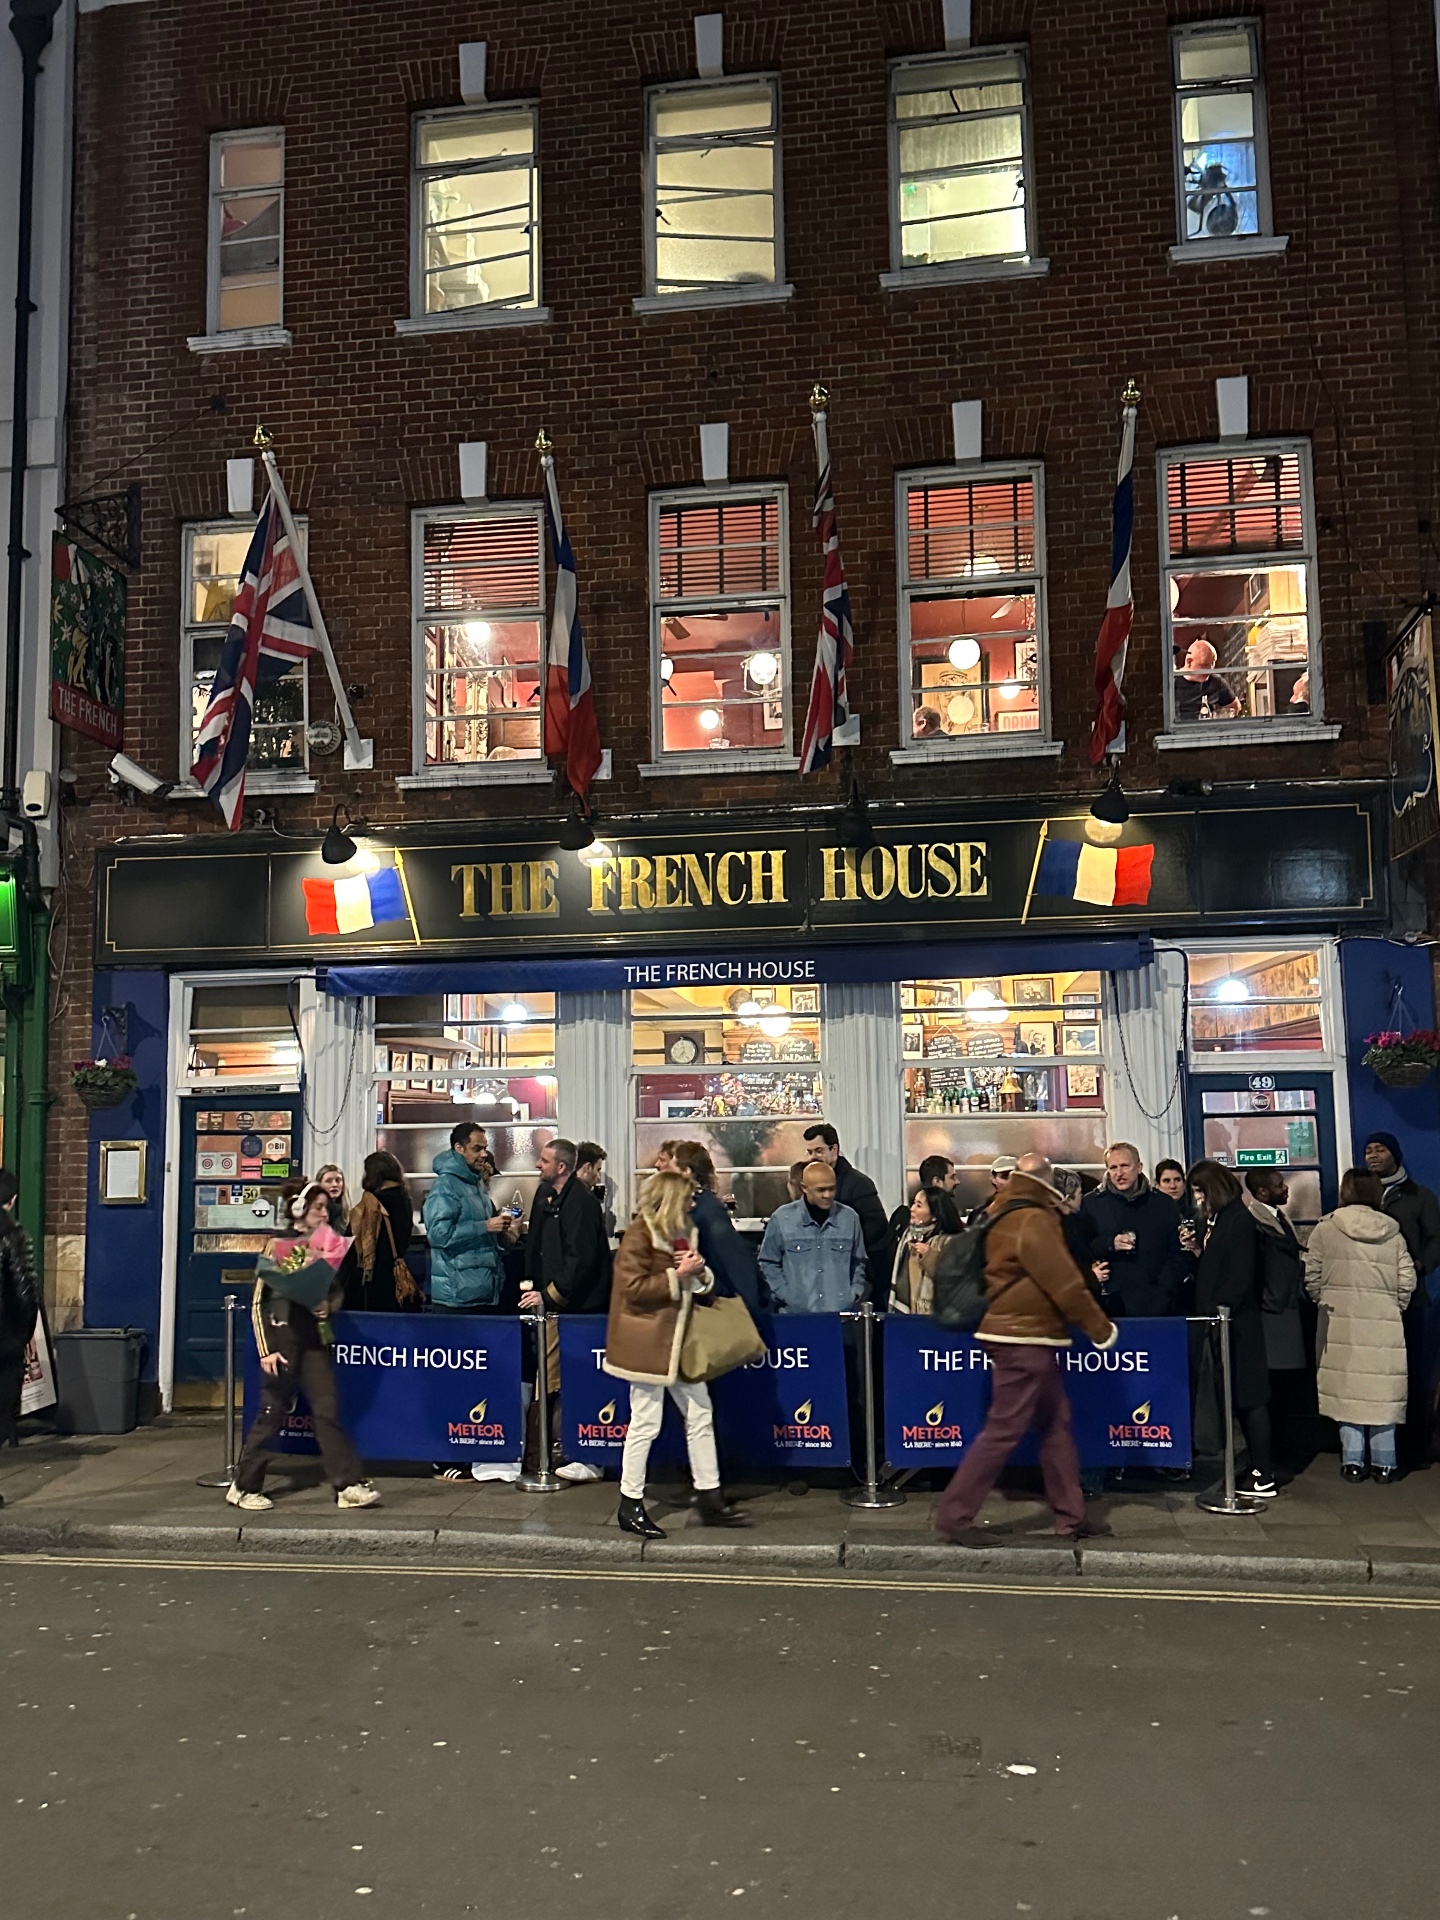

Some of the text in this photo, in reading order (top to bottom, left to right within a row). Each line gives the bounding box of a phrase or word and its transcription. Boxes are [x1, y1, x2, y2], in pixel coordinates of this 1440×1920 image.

[58, 686, 117, 737] THE FRENCH
[451, 842, 988, 920] THE FRENCH HOUSE
[623, 960, 815, 983] THE FRENCH HOUSE
[1252, 1076, 1273, 1088] 49
[1256, 1153, 1273, 1161] Exit
[413, 1347, 488, 1370] HOUSE
[918, 1349, 963, 1371] THE
[1067, 1351, 1150, 1373] HOUSE
[447, 1422, 505, 1439] METEOR
[773, 1424, 832, 1440] METEOR
[902, 1425, 962, 1441] METEOR
[1108, 1424, 1172, 1441] METEOR
[805, 1440, 820, 1448] since
[1142, 1440, 1158, 1448] since
